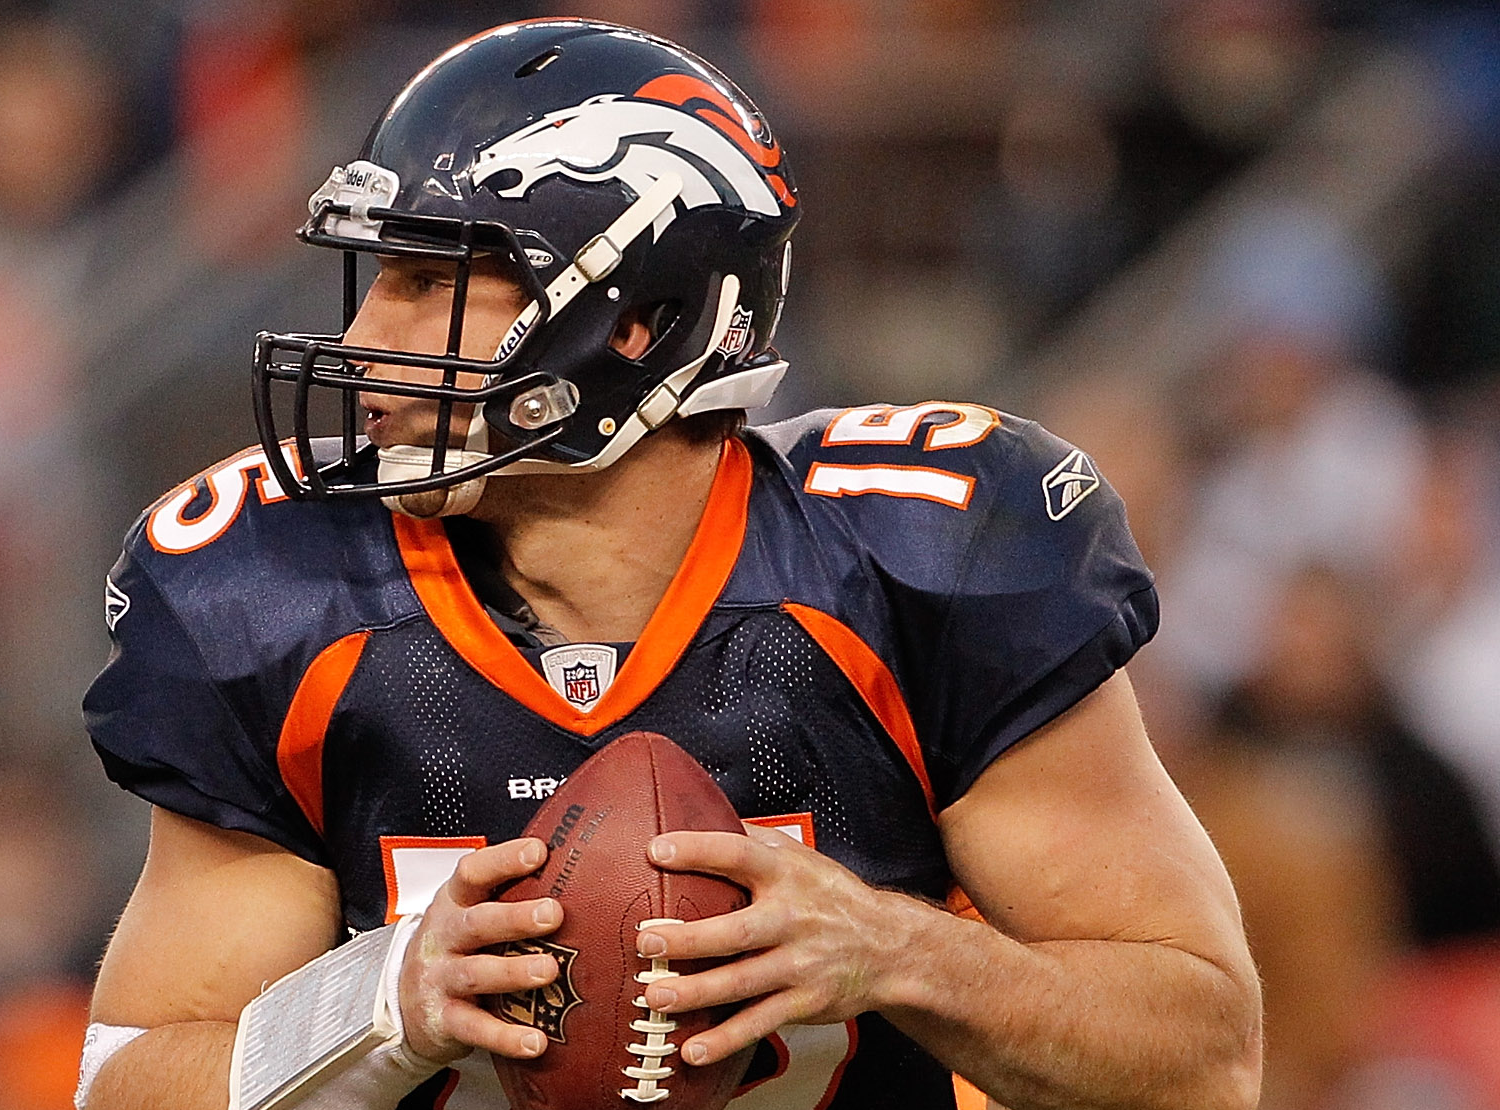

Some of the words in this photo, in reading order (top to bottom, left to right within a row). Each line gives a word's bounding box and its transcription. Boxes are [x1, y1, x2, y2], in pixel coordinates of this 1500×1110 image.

[145, 436, 306, 555] 5
[804, 401, 1000, 511] 15
[567, 680, 596, 701] NFL
